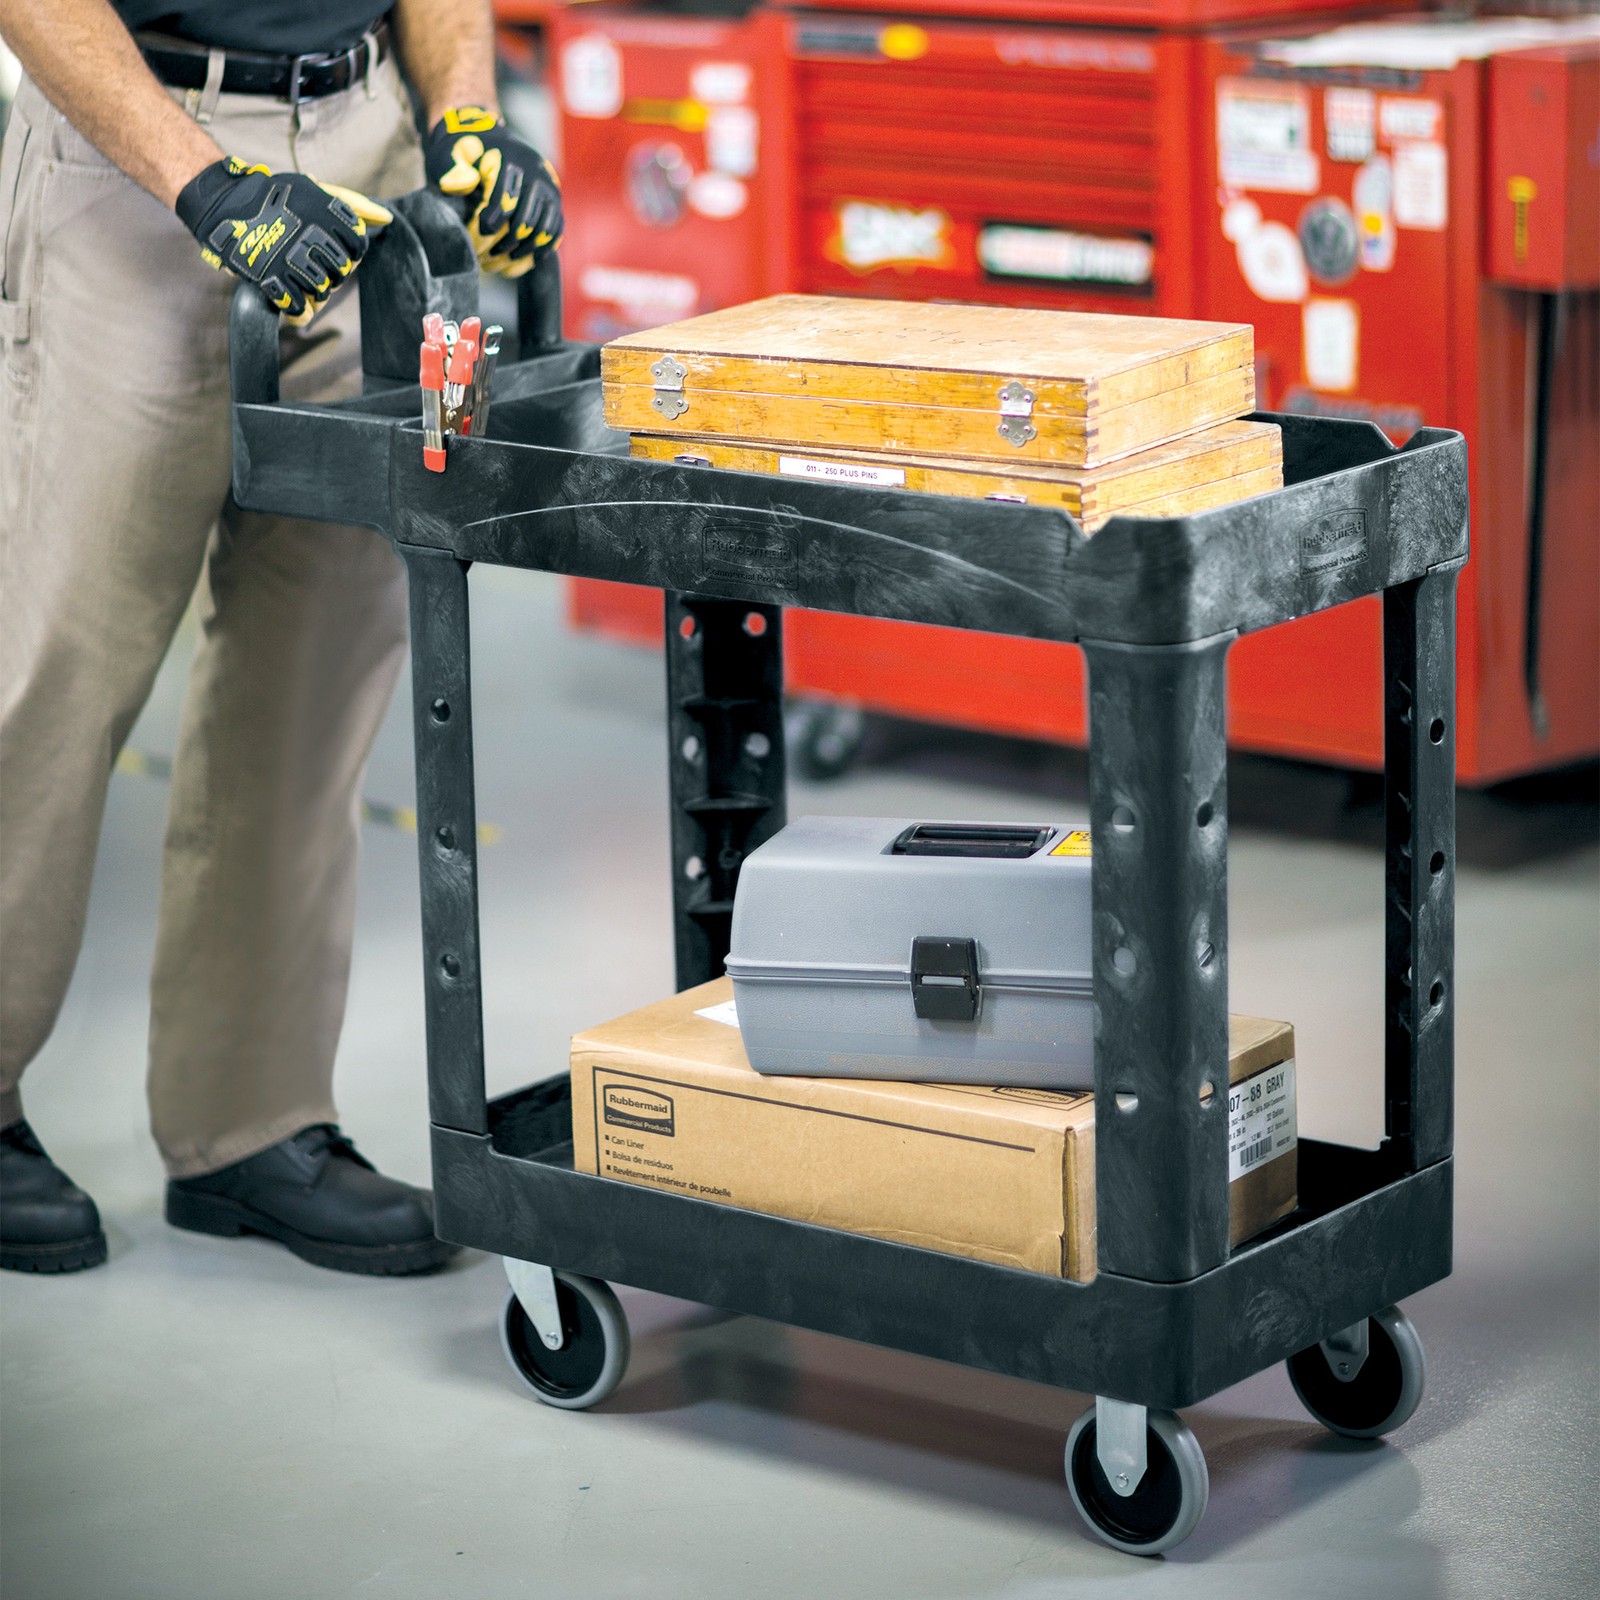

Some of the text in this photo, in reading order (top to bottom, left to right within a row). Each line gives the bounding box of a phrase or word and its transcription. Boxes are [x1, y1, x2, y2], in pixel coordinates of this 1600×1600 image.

[840, 468, 859, 478] PLUS
[861, 471, 878, 480] PINS
[1303, 521, 1362, 549] Rubbermaid
[711, 539, 792, 561] Rubbermaid
[705, 567, 756, 581] Commercial
[1229, 1083, 1262, 1113] 07-88
[1266, 1071, 1285, 1095] GRAY
[609, 1094, 668, 1114] Rubbermaid
[606, 1114, 672, 1134] Commercial Products
[611, 1135, 645, 1149] Can Liner
[612, 1150, 674, 1171] Bolsa de residuos
[613, 1165, 732, 1197] Revêtement intérieur de poubelle
